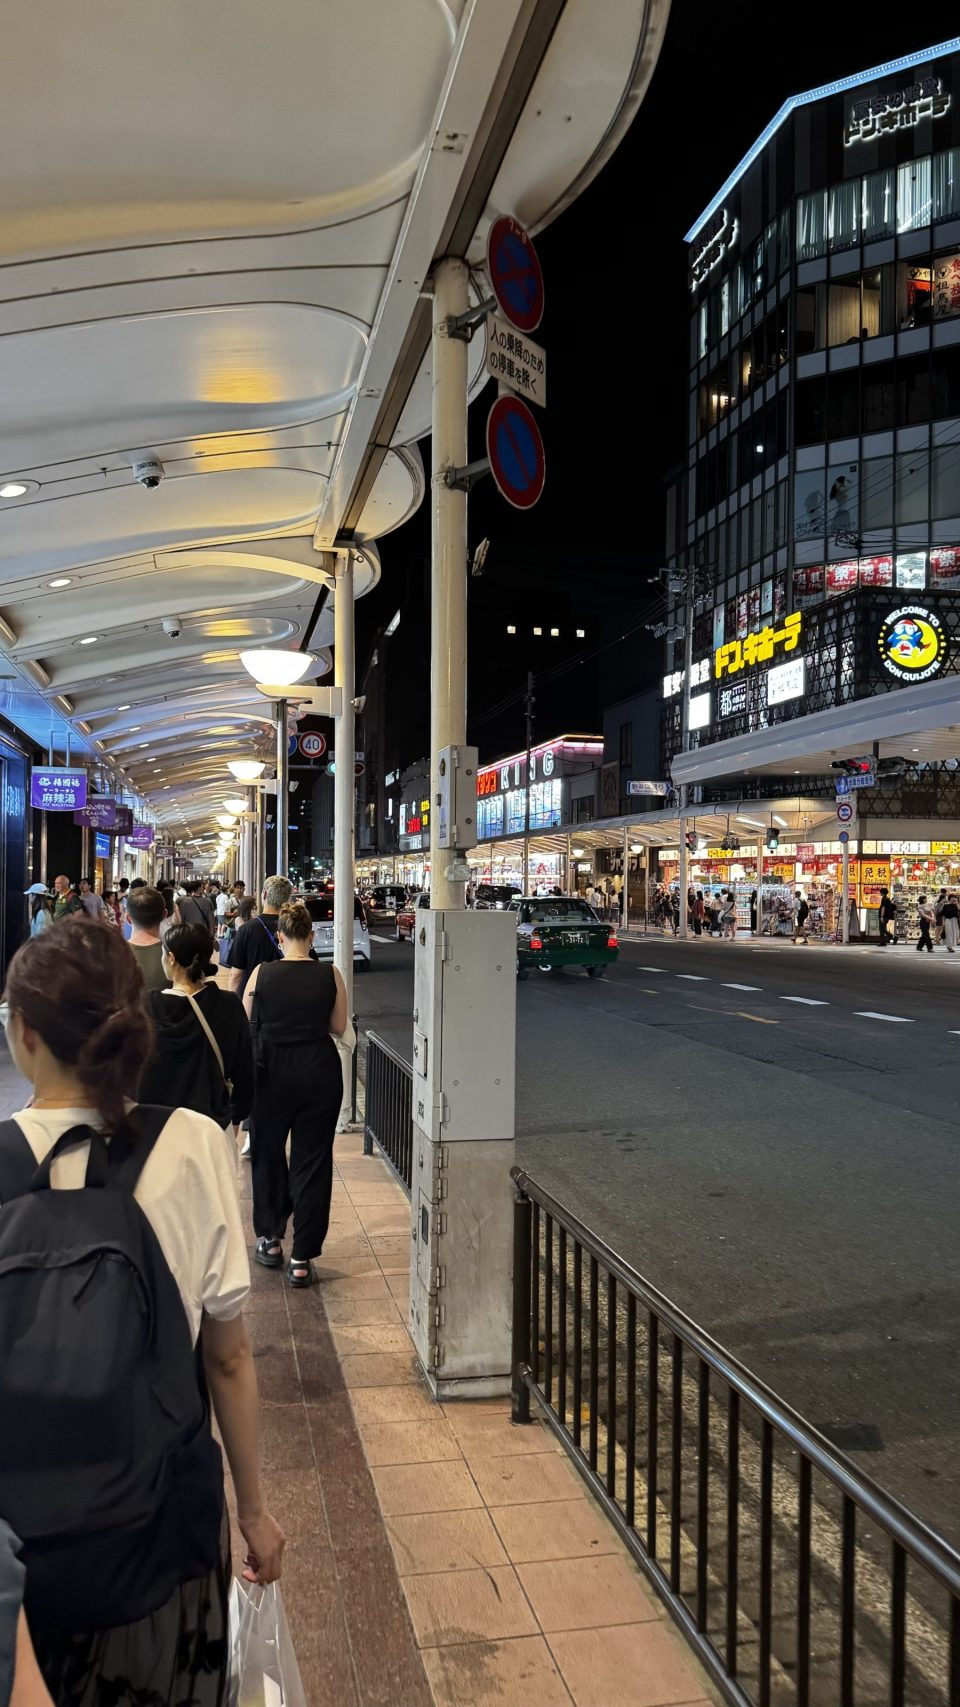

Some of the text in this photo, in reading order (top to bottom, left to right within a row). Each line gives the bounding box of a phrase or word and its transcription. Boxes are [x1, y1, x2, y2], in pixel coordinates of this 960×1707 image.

[490, 322, 545, 375] 人の乗降のため
[489, 351, 538, 395] の停車を除く
[884, 606, 940, 627] WELCOME TO
[883, 659, 941, 681] DON QUIJOTE
[305, 738, 320, 750] 40
[500, 749, 554, 790] KING
[42, 792, 76, 804] 麻辣湯
[865, 867, 887, 877] 免税
